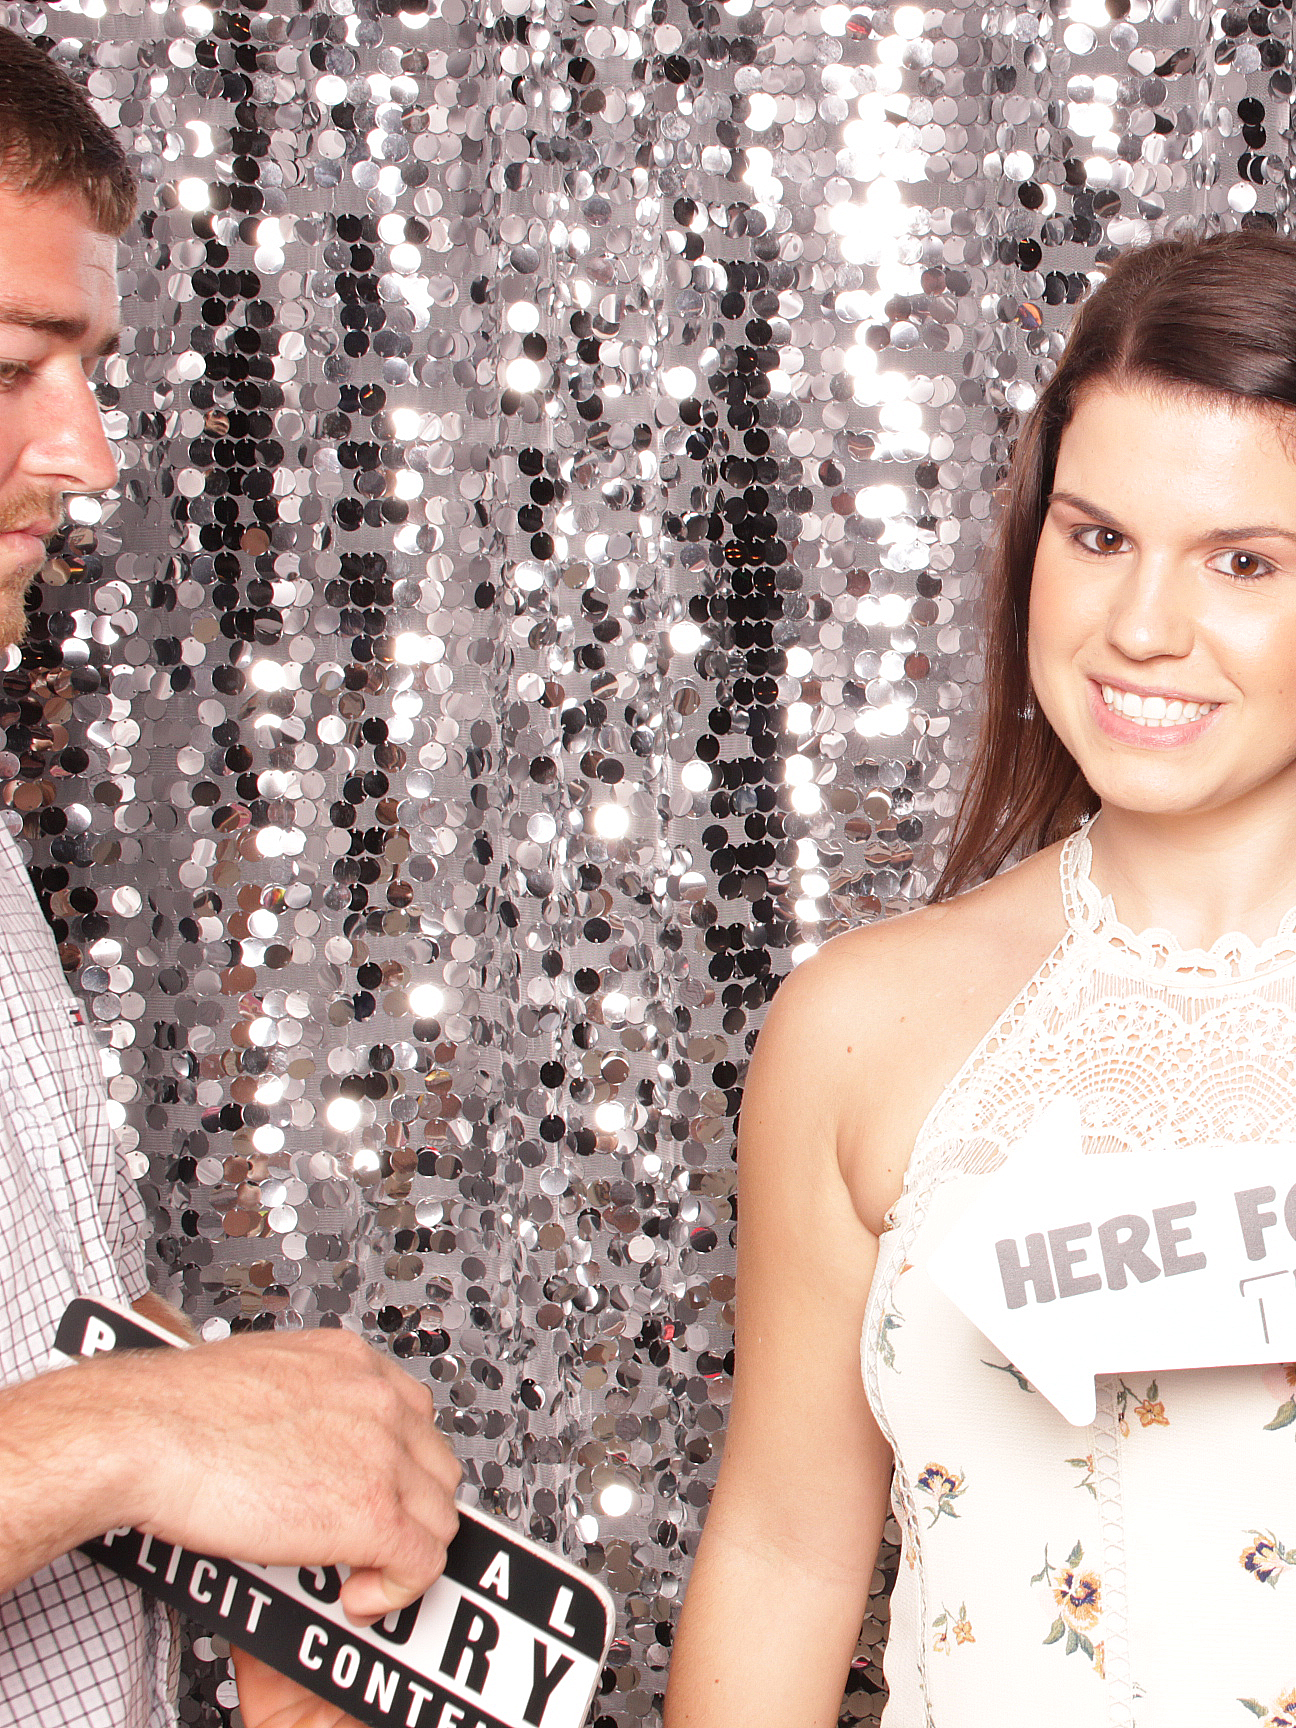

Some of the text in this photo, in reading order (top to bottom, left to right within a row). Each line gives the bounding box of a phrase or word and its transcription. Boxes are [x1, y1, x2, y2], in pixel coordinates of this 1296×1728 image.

[995, 1200, 1207, 1310] HERE
[103, 1526, 272, 1634] LICIT
[298, 1624, 489, 1728] CONTE
